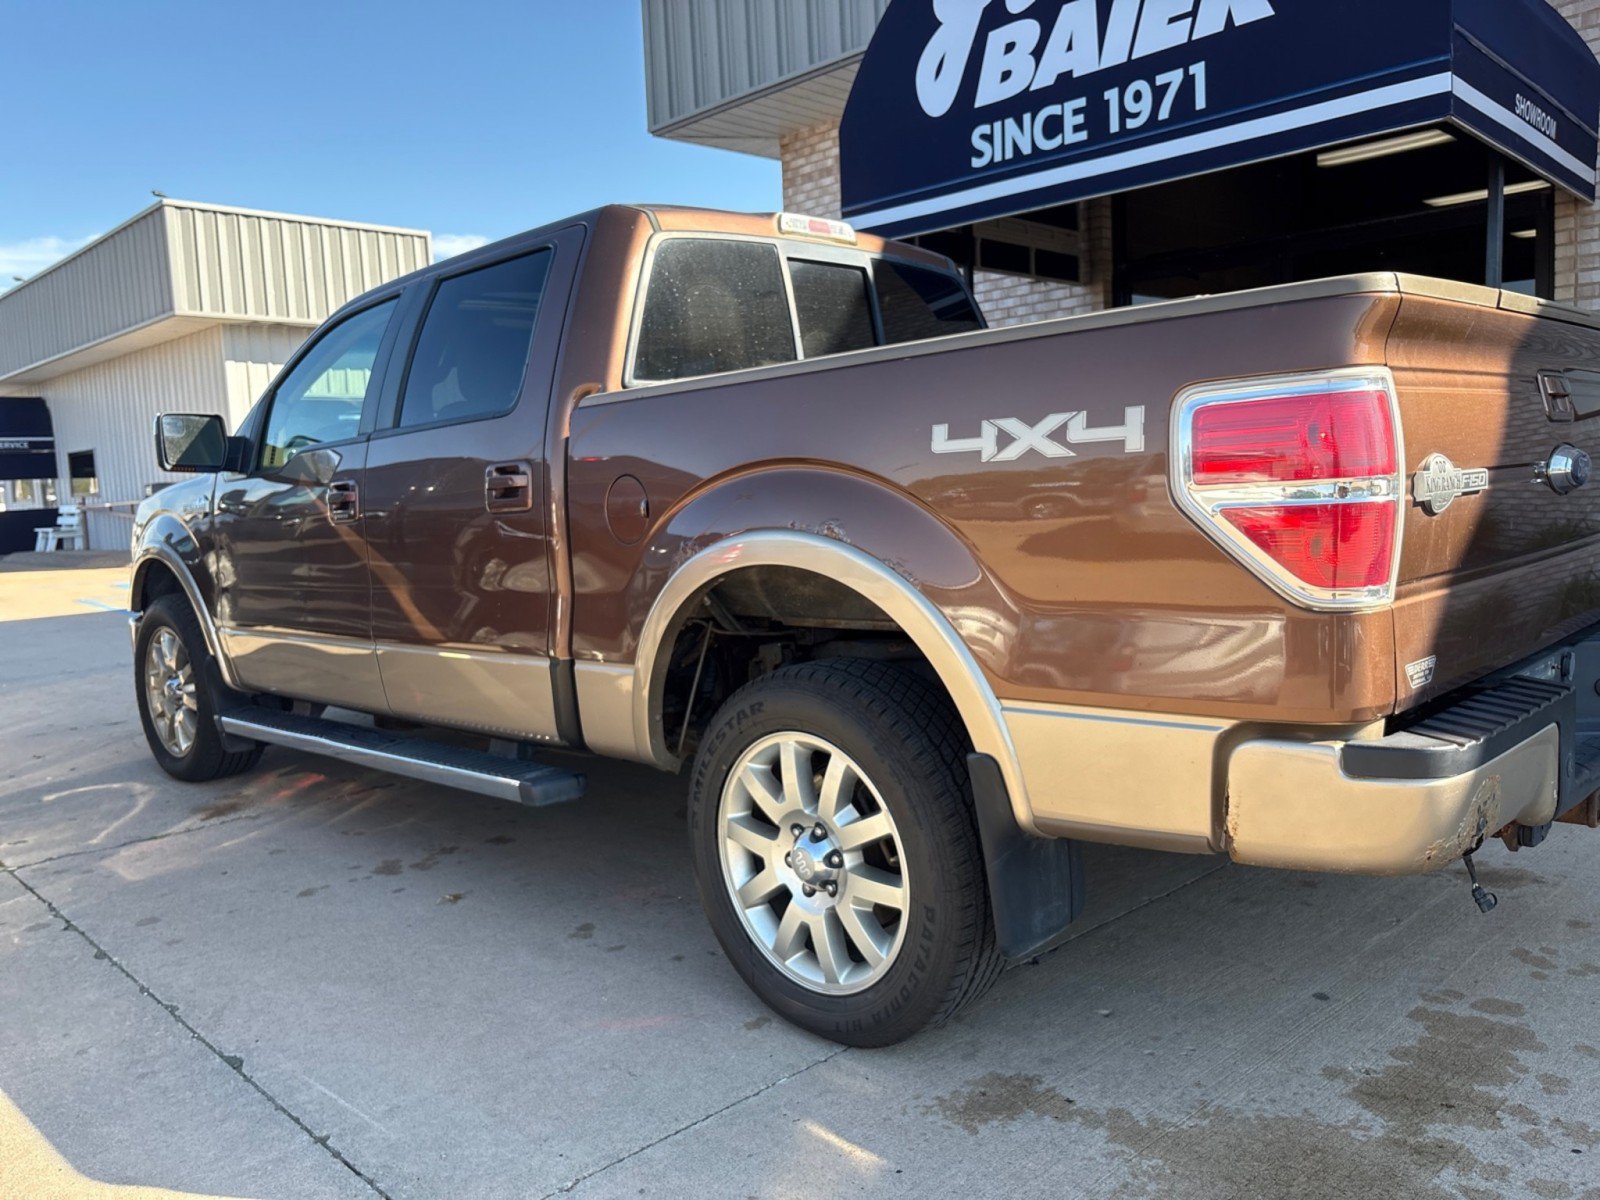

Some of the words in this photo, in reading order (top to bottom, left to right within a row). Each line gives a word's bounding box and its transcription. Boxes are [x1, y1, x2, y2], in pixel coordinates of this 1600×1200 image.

[971, 97, 1088, 168] SINCE
[1104, 60, 1206, 134] 1971
[1515, 93, 1557, 140] SHOWROOM
[0, 441, 29, 449] ERVICE
[693, 701, 765, 802] MILESTAR
